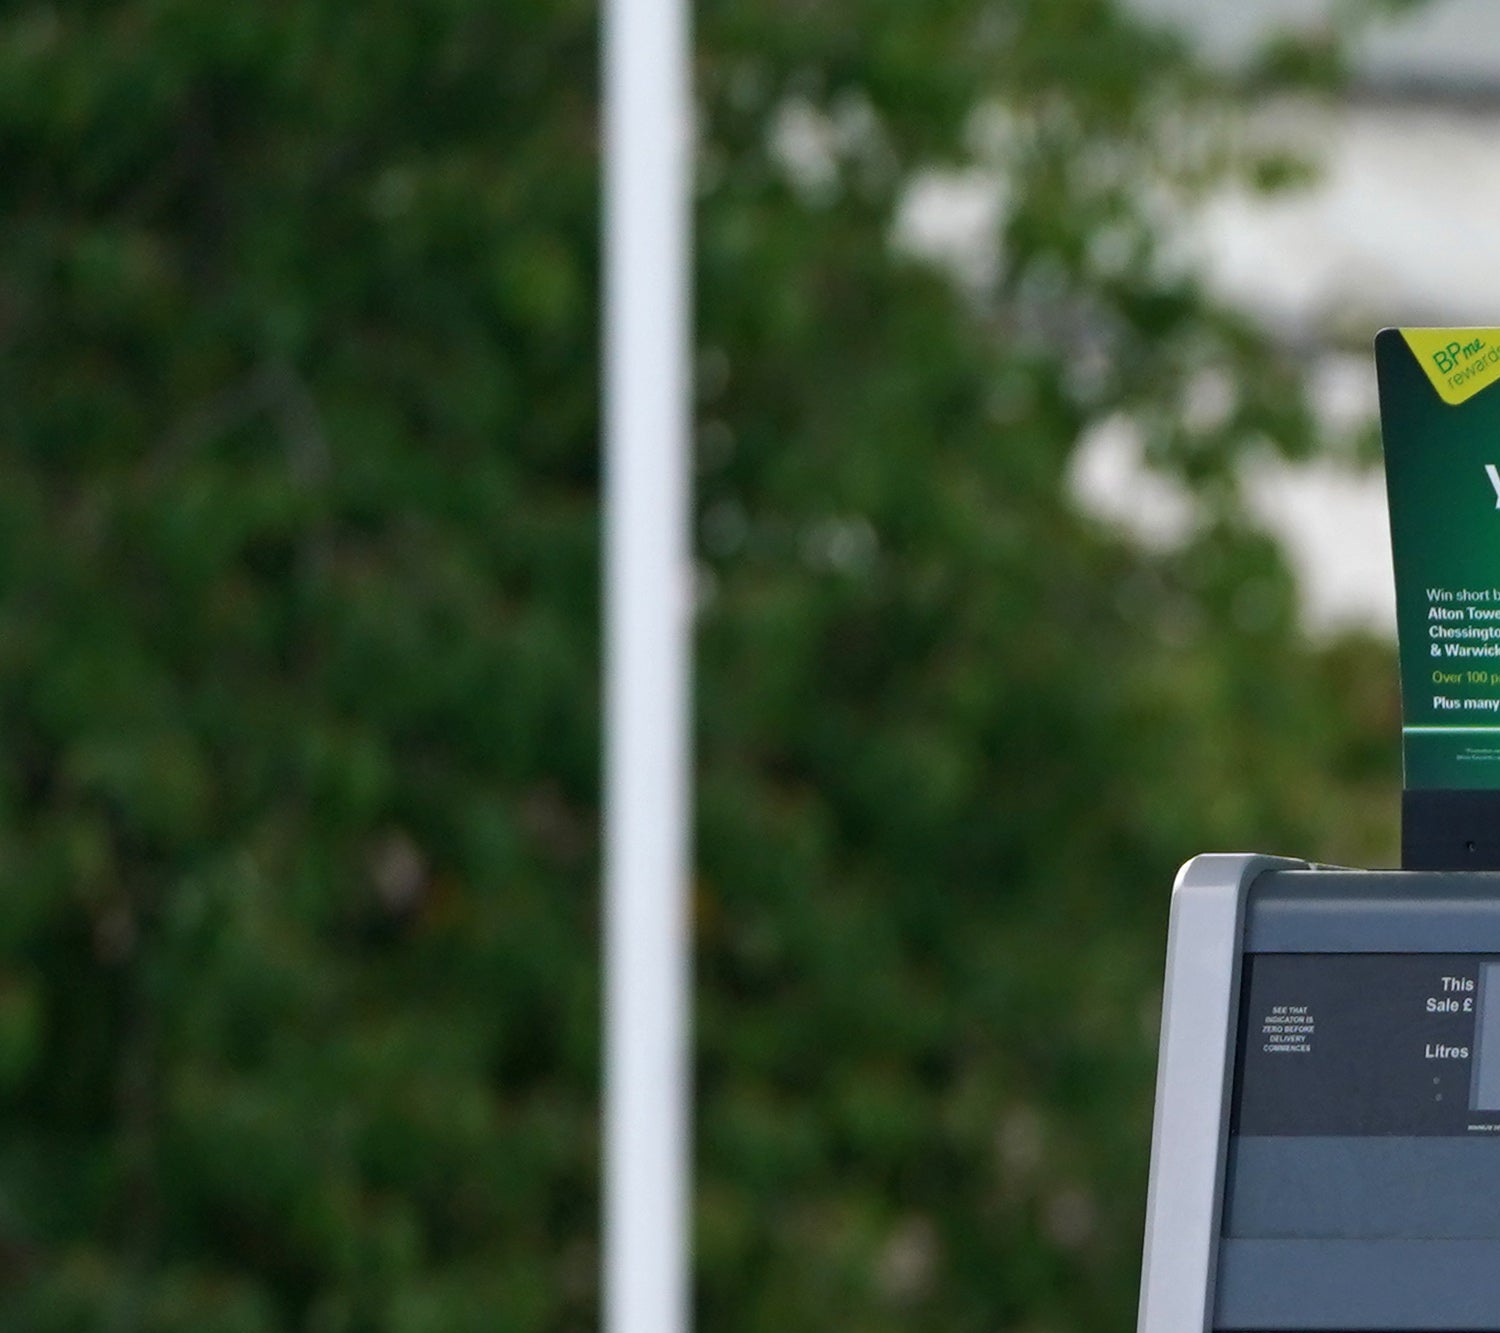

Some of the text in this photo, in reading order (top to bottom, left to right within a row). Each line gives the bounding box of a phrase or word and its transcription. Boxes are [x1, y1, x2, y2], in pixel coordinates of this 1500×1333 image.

[1426, 589, 1452, 601] Win
[1456, 589, 1489, 601] short
[1428, 607, 1464, 620] Alton
[1431, 645, 1441, 657] &
[1433, 696, 1461, 709] Plus
[1464, 699, 1500, 711] many
[1442, 976, 1474, 991] This
[1426, 998, 1473, 1012] Sale £
[1425, 1044, 1469, 1058] Litres
